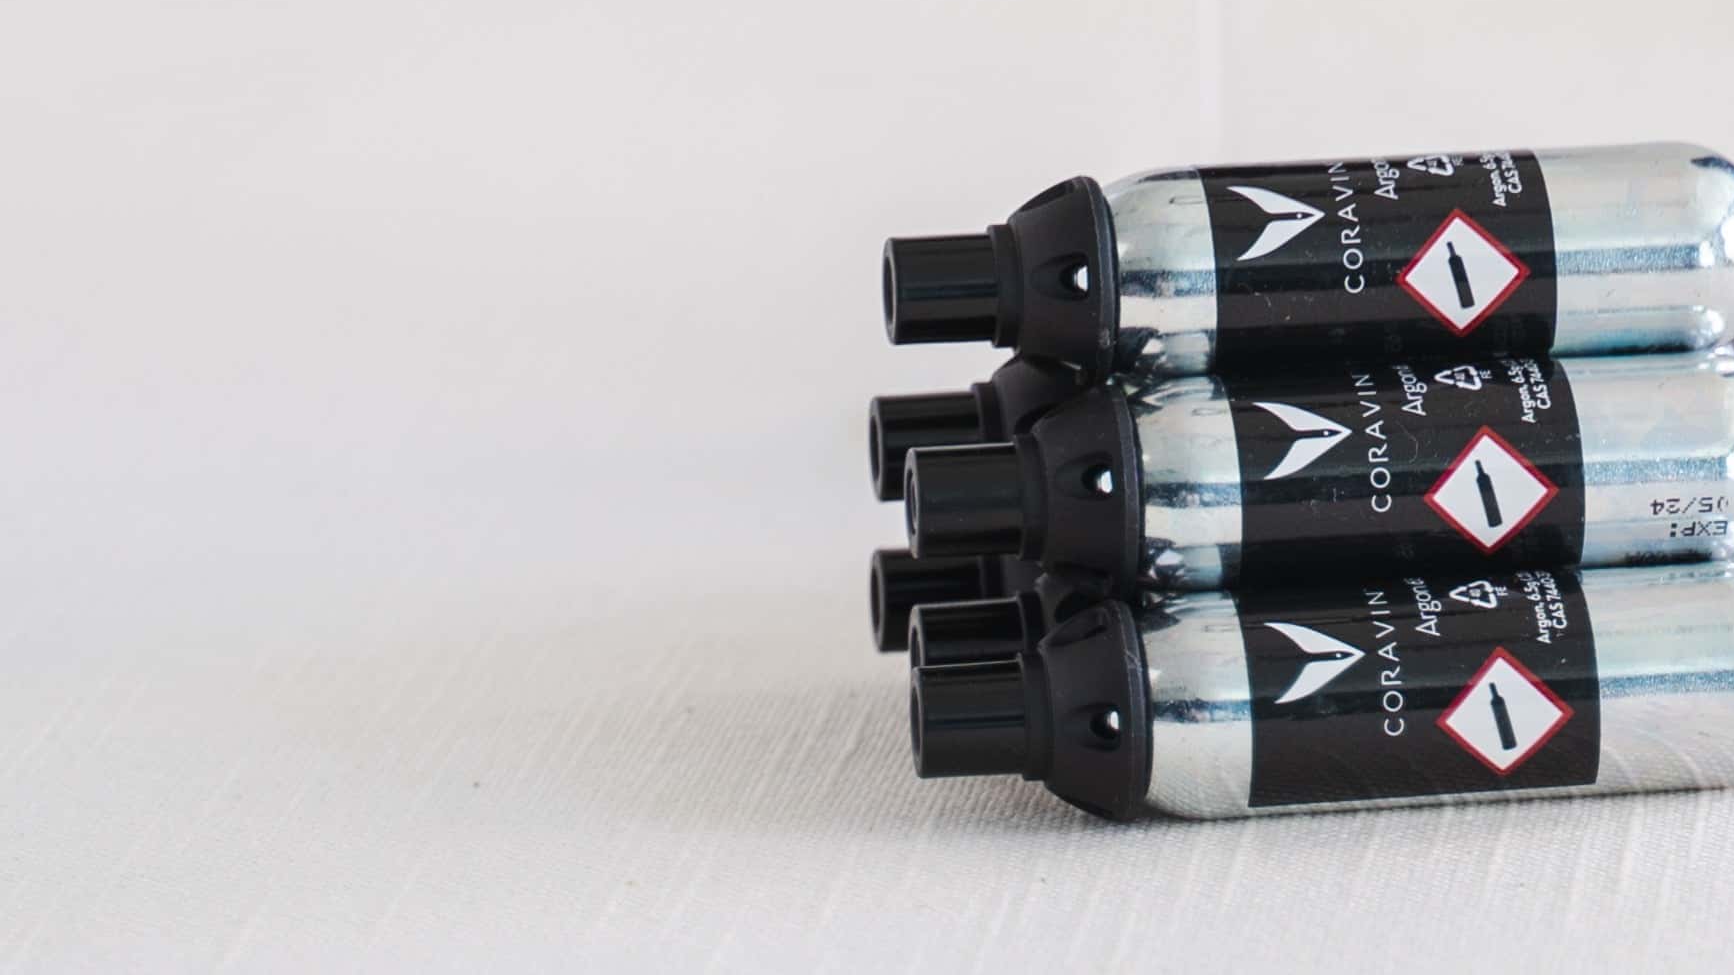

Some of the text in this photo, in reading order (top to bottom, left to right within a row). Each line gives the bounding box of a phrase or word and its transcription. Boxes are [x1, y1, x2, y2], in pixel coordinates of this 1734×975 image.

[1533, 384, 1552, 410] CAS
[1351, 374, 1392, 513] CORAVIN
[1669, 520, 1729, 538] EXP:
[1549, 602, 1568, 630] CAS
[1366, 591, 1405, 737] CORAVIN
